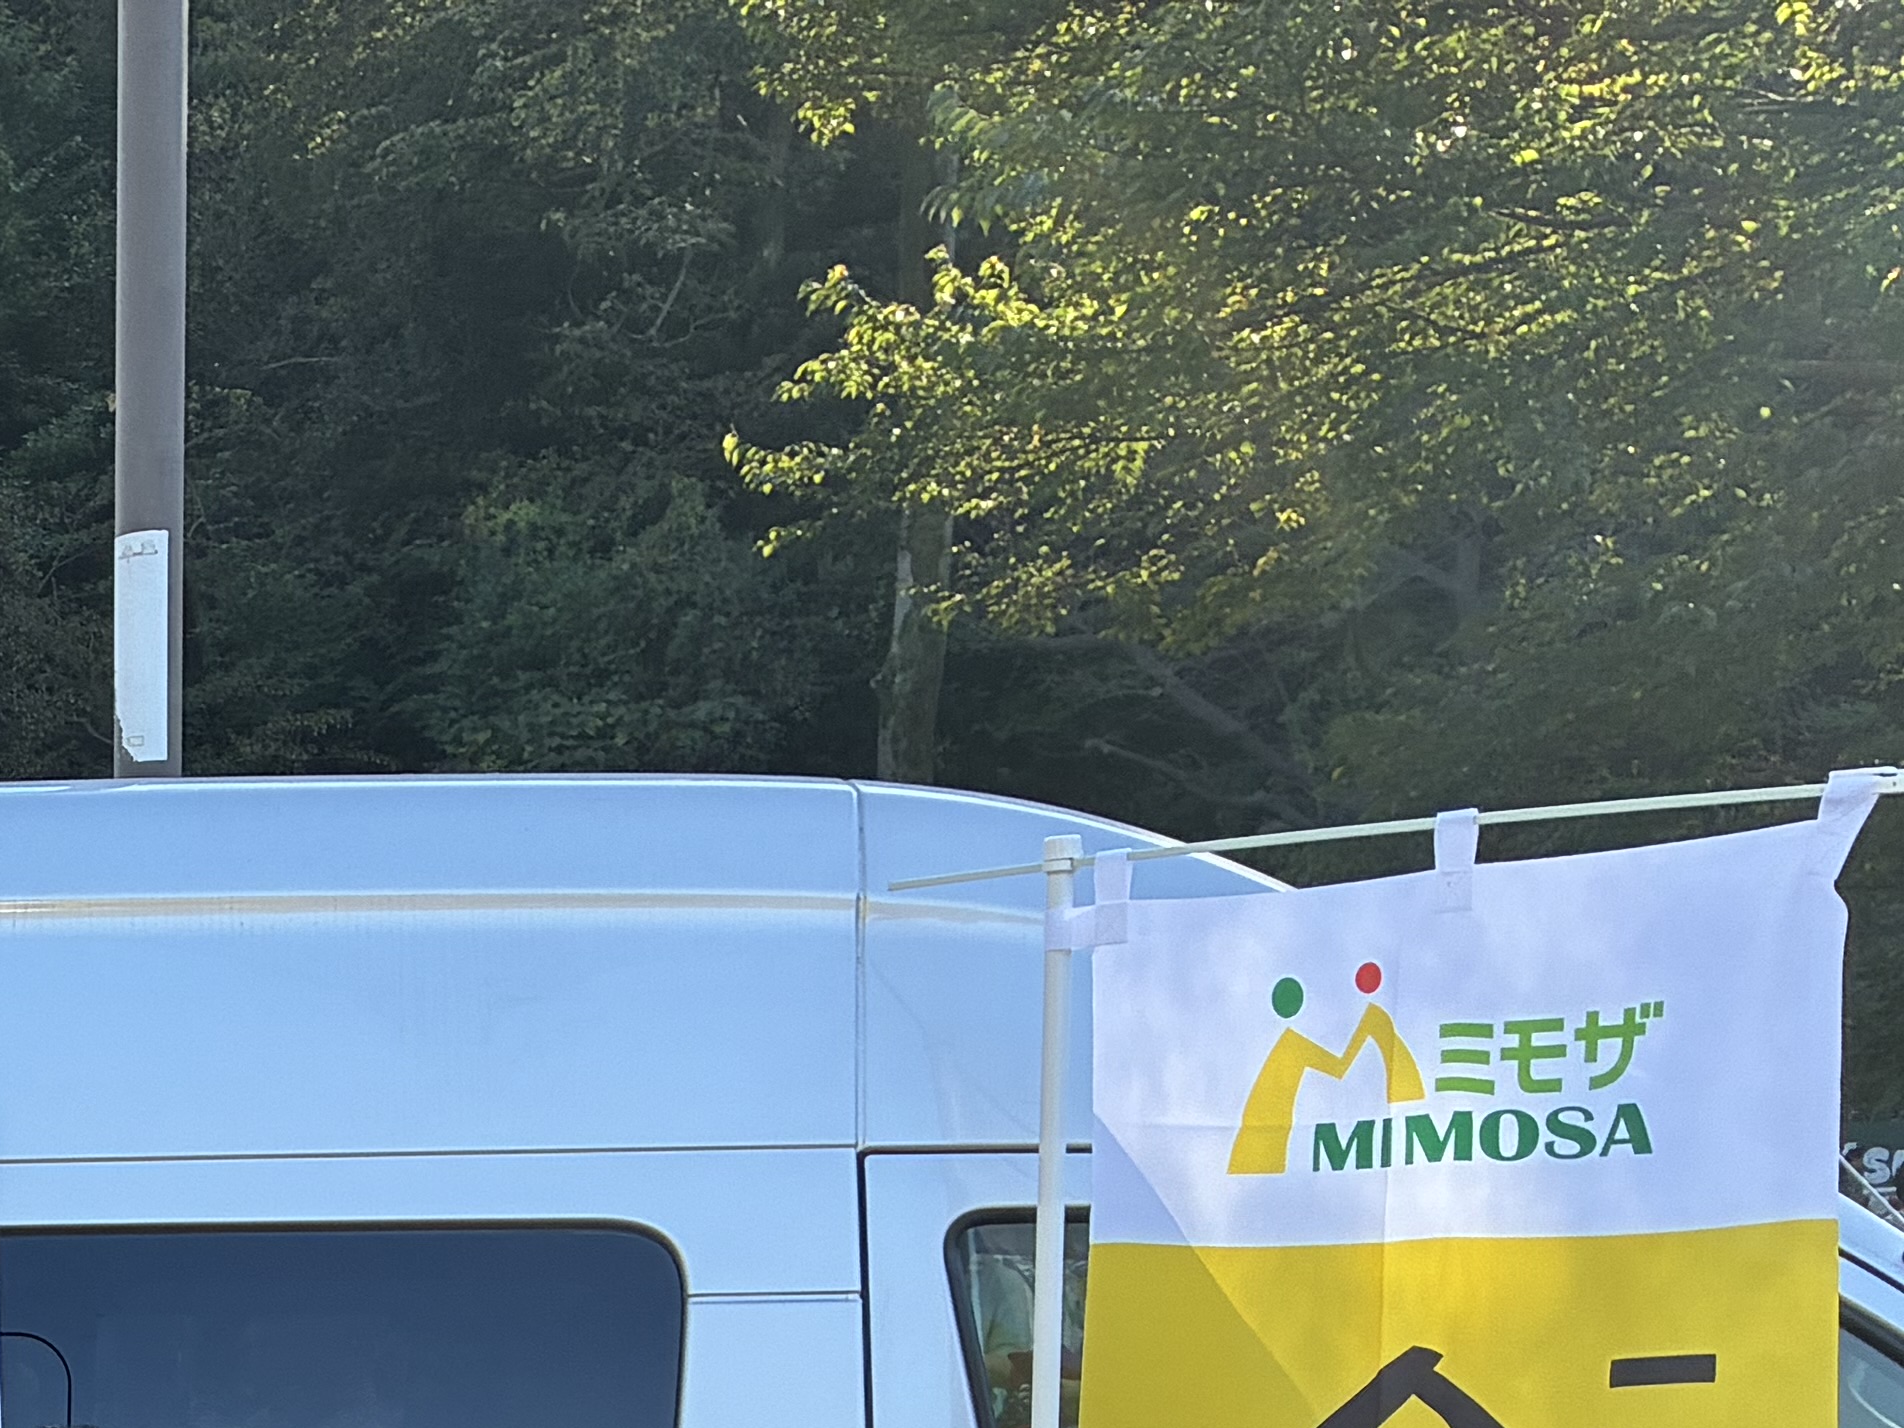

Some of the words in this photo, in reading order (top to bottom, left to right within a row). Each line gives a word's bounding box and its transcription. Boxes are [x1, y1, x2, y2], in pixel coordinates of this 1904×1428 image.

[1435, 1000, 1665, 1096] ミモザ
[1312, 1103, 1653, 1172] MIMOSA
